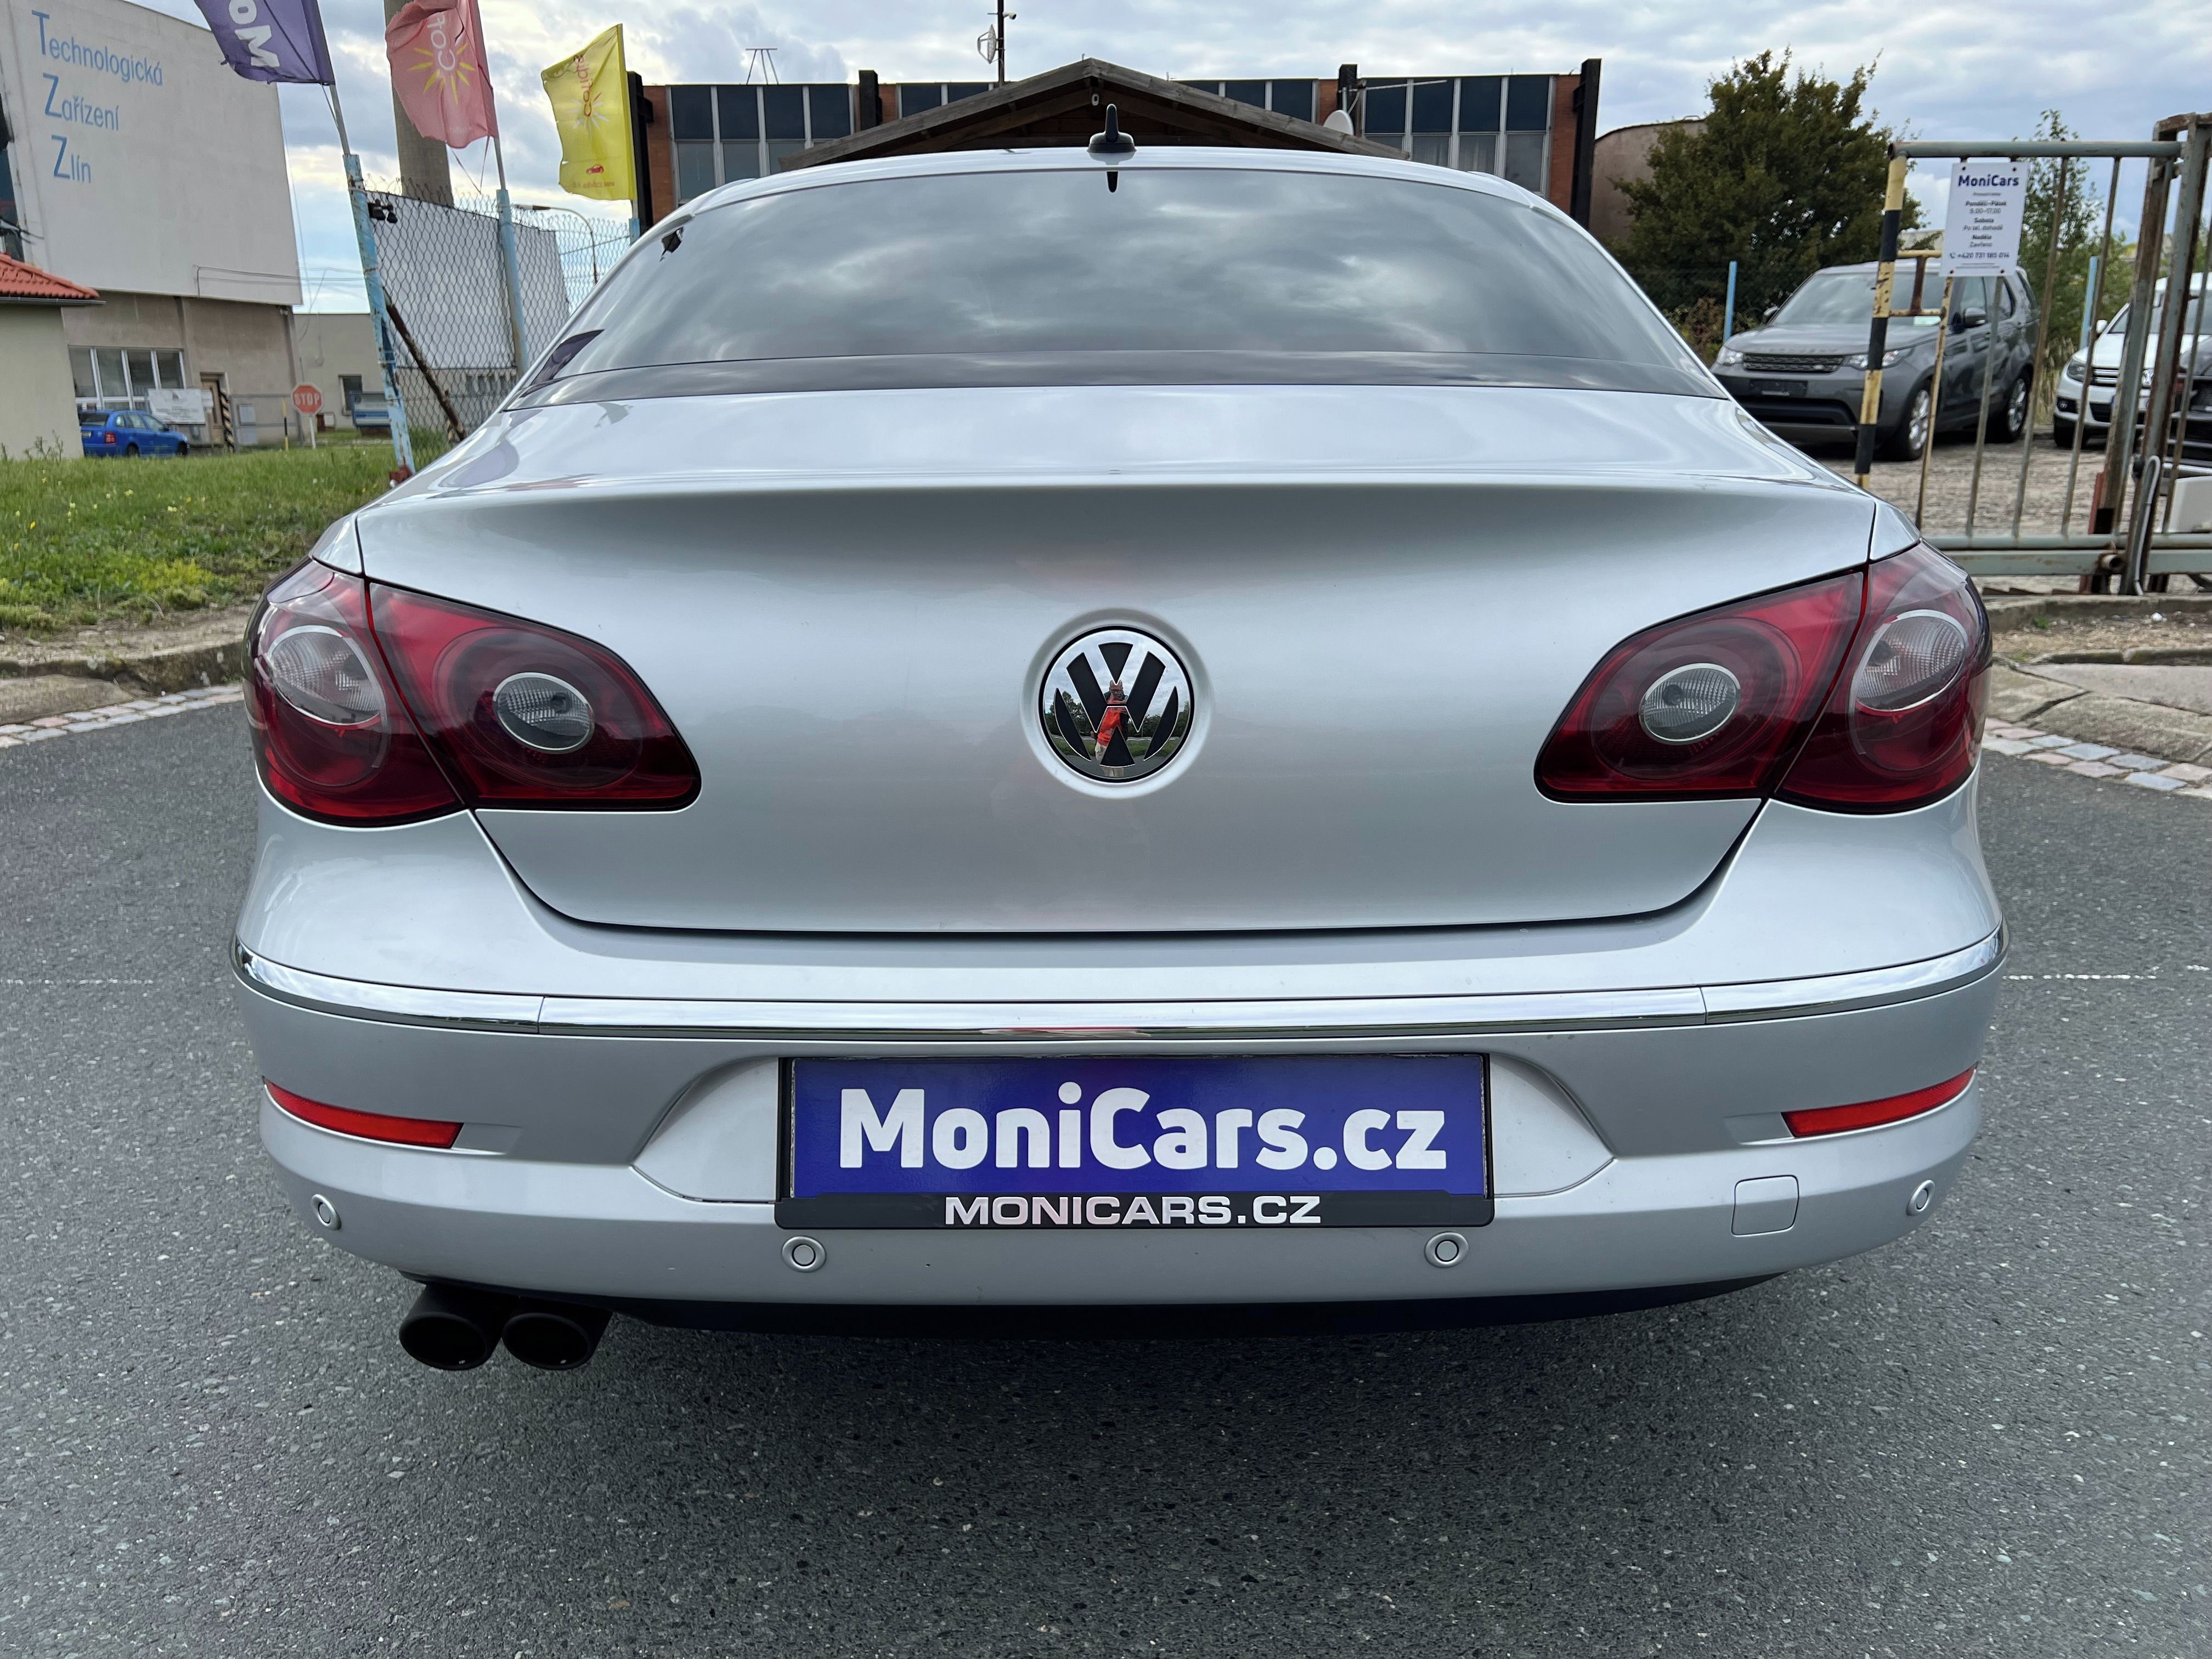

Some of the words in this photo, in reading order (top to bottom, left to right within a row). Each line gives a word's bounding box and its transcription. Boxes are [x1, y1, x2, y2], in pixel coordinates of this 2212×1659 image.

[31, 10, 163, 87] Technologická
[43, 72, 120, 131] Zařízení
[52, 134, 91, 184] Zlín
[1958, 174, 2019, 187] MoniCars
[294, 392, 320, 406] STOP
[839, 1081, 1447, 1171] MoniCars.cz
[944, 1195, 1321, 1227] MONICARS.CZ
